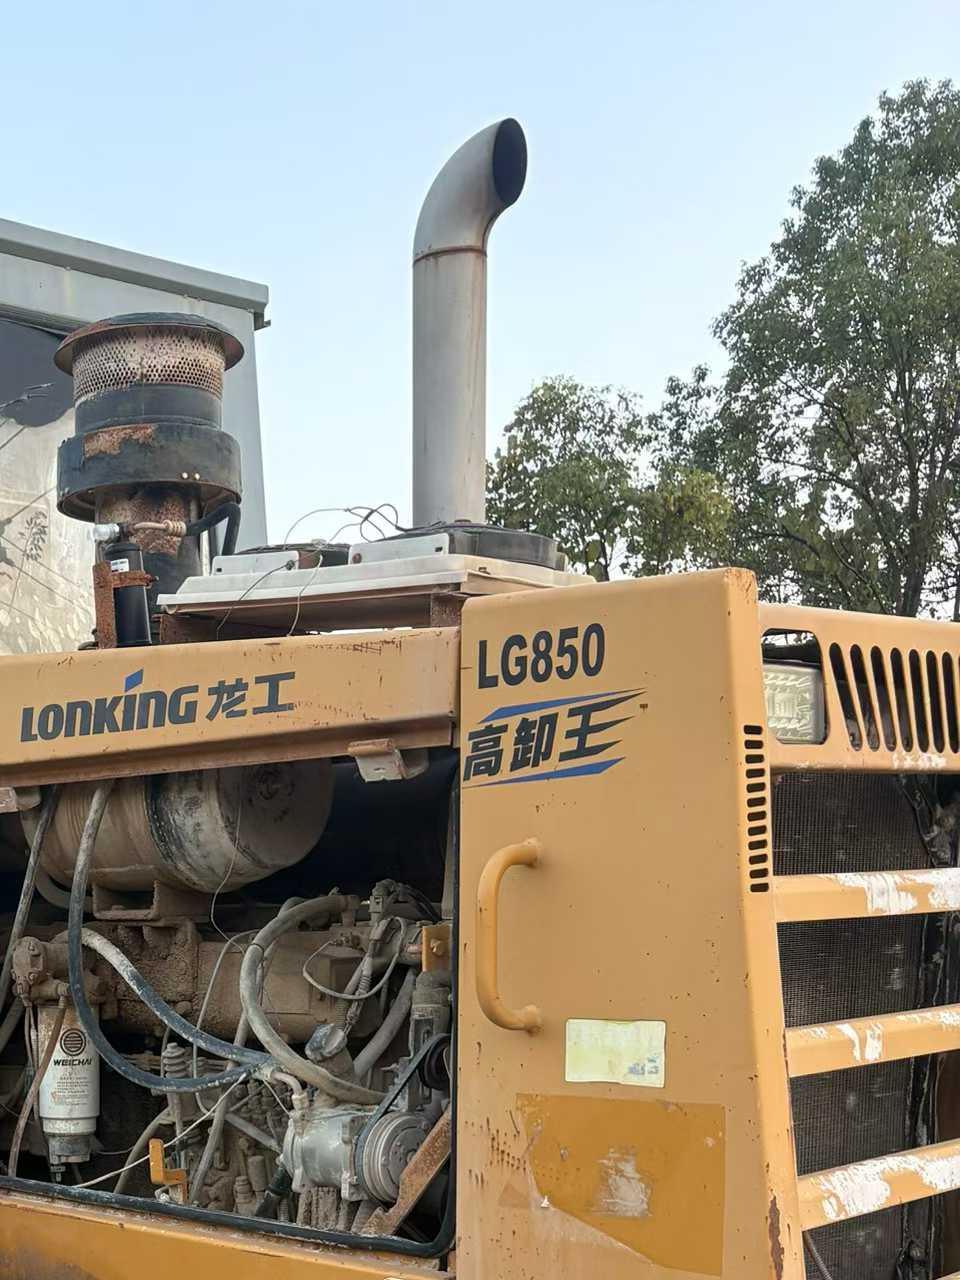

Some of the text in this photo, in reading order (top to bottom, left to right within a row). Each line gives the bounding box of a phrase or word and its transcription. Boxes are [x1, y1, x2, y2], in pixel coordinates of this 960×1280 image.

[478, 622, 606, 689] LG850
[205, 671, 296, 721] 龙工
[463, 691, 647, 781] 高卸王
[53, 1058, 92, 1066] WEICHAI
